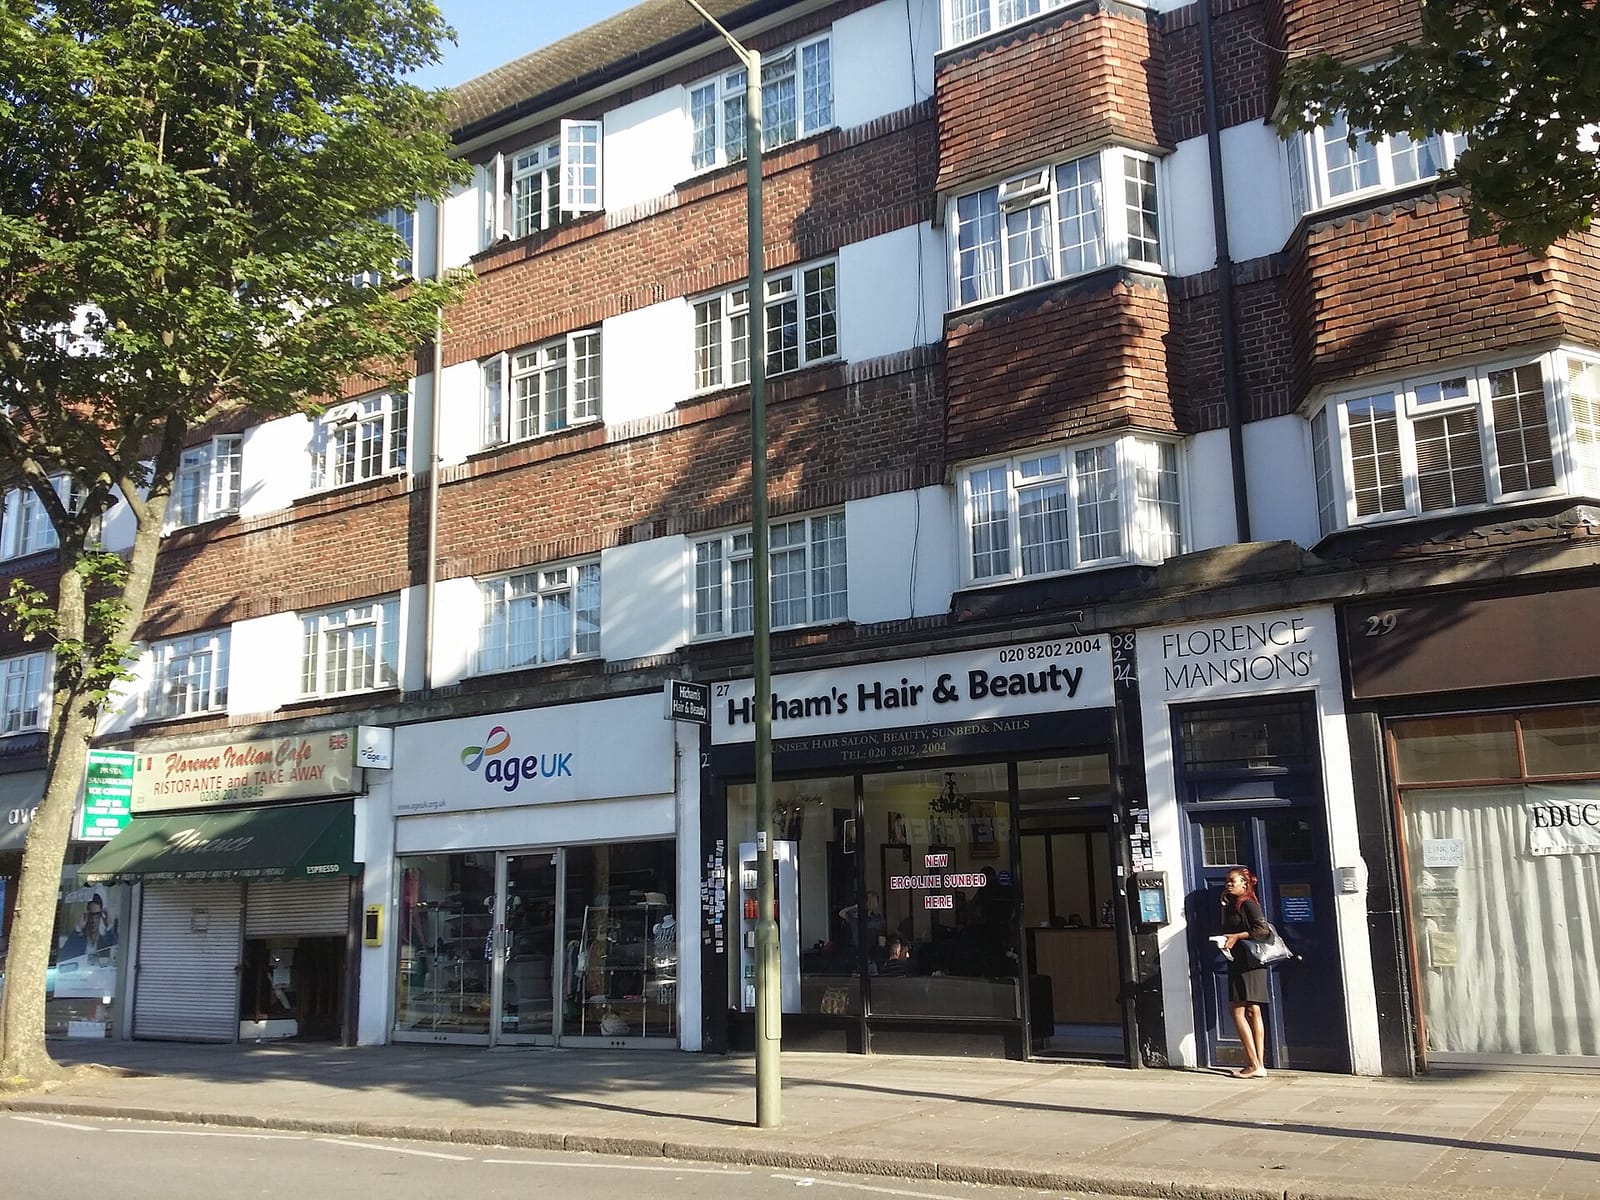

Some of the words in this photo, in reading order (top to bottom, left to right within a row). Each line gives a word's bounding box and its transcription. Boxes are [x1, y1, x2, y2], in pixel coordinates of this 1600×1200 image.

[1365, 613, 1397, 637] 29
[1162, 617, 1308, 659] FLORENCE
[999, 647, 1024, 663] 020
[1027, 643, 1062, 660] 8202
[1065, 638, 1102, 656] 2004
[1164, 650, 1310, 691] MANSIONS
[716, 684, 730, 697] 27
[728, 686, 848, 725] Hiham's
[857, 677, 924, 712] Hair
[932, 673, 959, 704] &
[968, 663, 1083, 700] Beauty
[812, 738, 839, 750] HAIR
[993, 719, 1030, 733] NAILS
[165, 752, 220, 778] Florence
[223, 746, 273, 769] Italian
[274, 739, 312, 767] Cafe
[868, 747, 886, 759] 020
[922, 742, 946, 754] 2004
[153, 776, 223, 796] RISTORANTE
[227, 772, 249, 788] and
[254, 768, 284, 785] TAKE
[290, 765, 326, 782] AWAY
[223, 789, 239, 801] 202
[1532, 803, 1600, 829] EDUC
[306, 864, 340, 874] ESPRESSO
[924, 853, 949, 868] NEW
[890, 874, 942, 890] ERGOLINE
[943, 873, 987, 888] SUNBED
[924, 894, 954, 909] HERE
